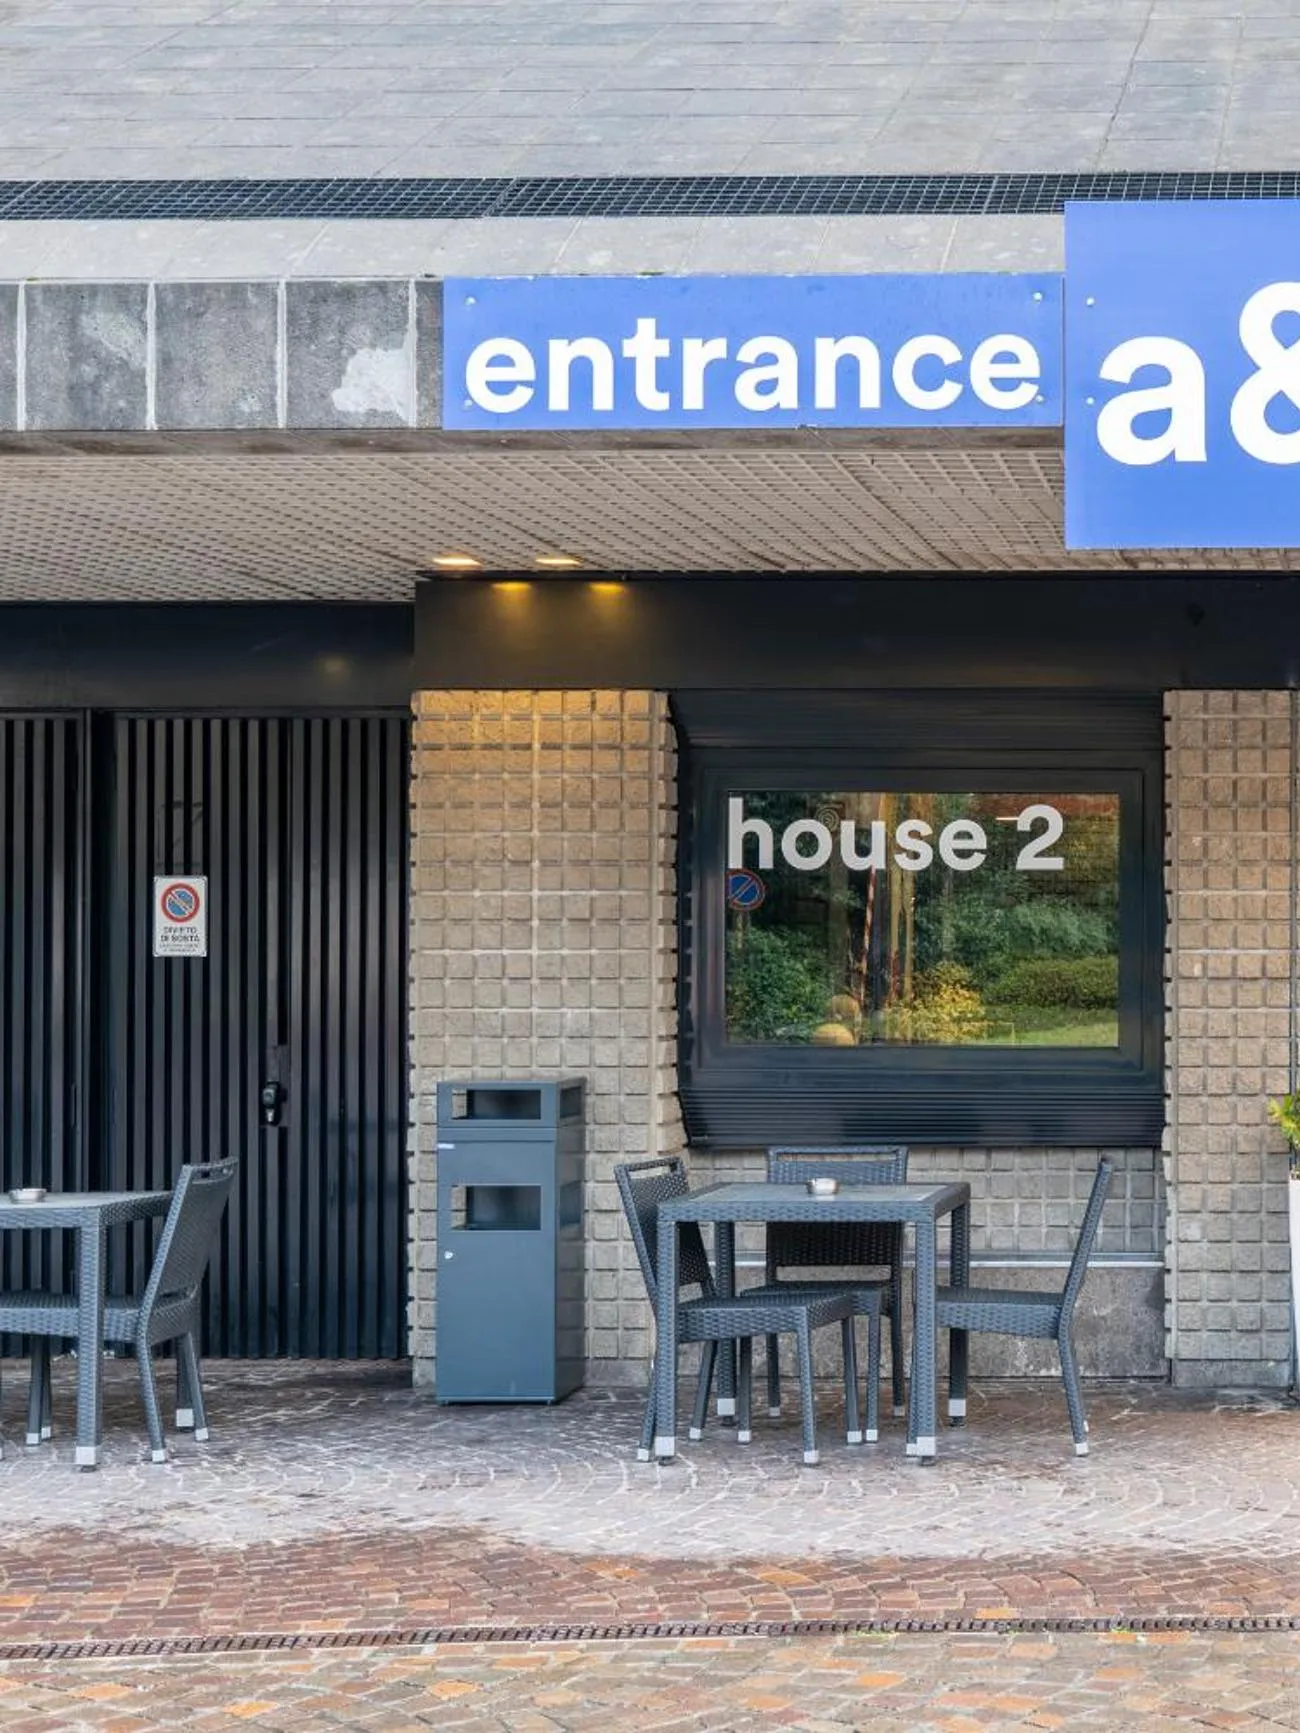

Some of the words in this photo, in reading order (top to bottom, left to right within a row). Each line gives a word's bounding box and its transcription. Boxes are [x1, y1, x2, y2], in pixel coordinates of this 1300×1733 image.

[465, 317, 1041, 413] entrance
[728, 797, 988, 871] house
[1014, 804, 1065, 870] 2
